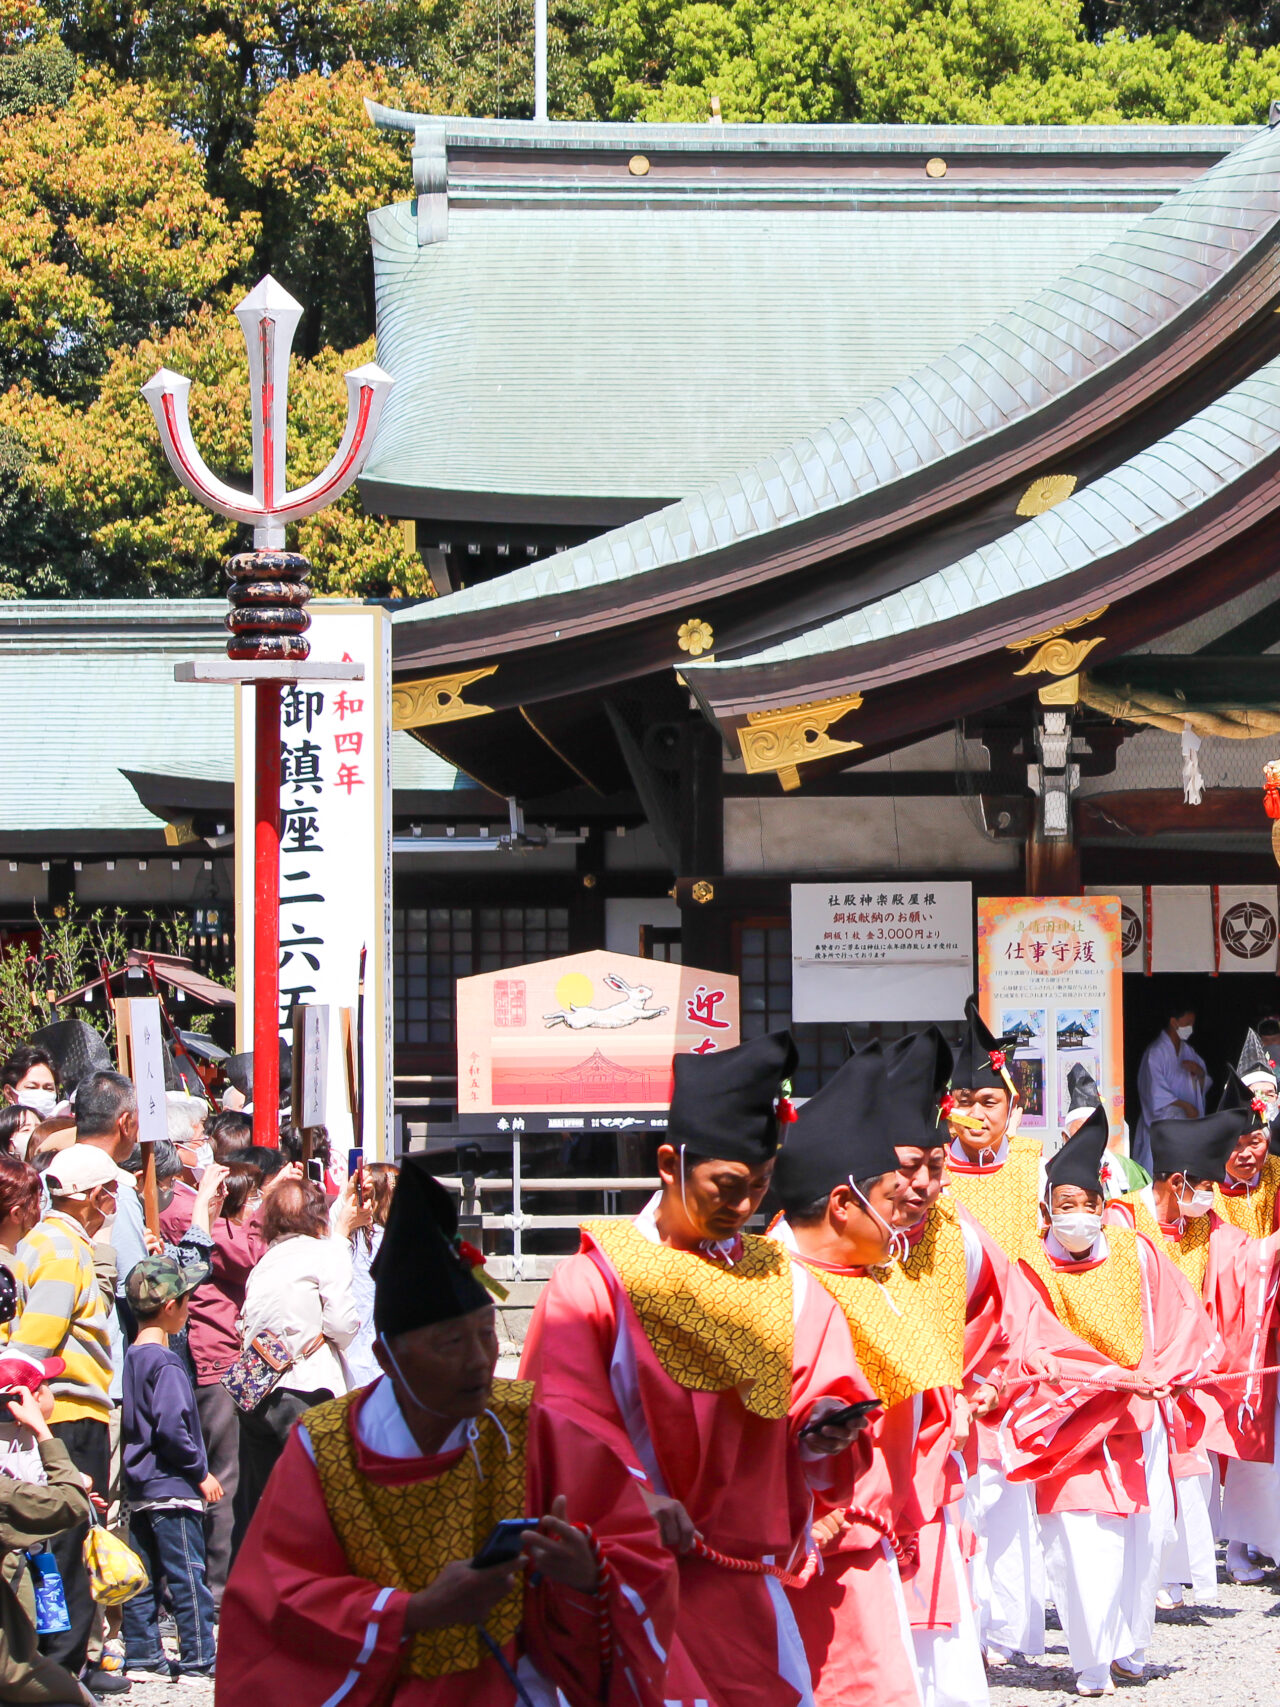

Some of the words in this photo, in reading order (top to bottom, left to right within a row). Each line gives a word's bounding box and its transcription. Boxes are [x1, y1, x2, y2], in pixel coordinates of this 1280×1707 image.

[828, 893, 937, 906] 社殿神楽殿屋根
[833, 911, 933, 923] 銅板献納のお願い
[1005, 940, 1096, 963] 仕事守護
[469, 1051, 480, 1102] 令和五年
